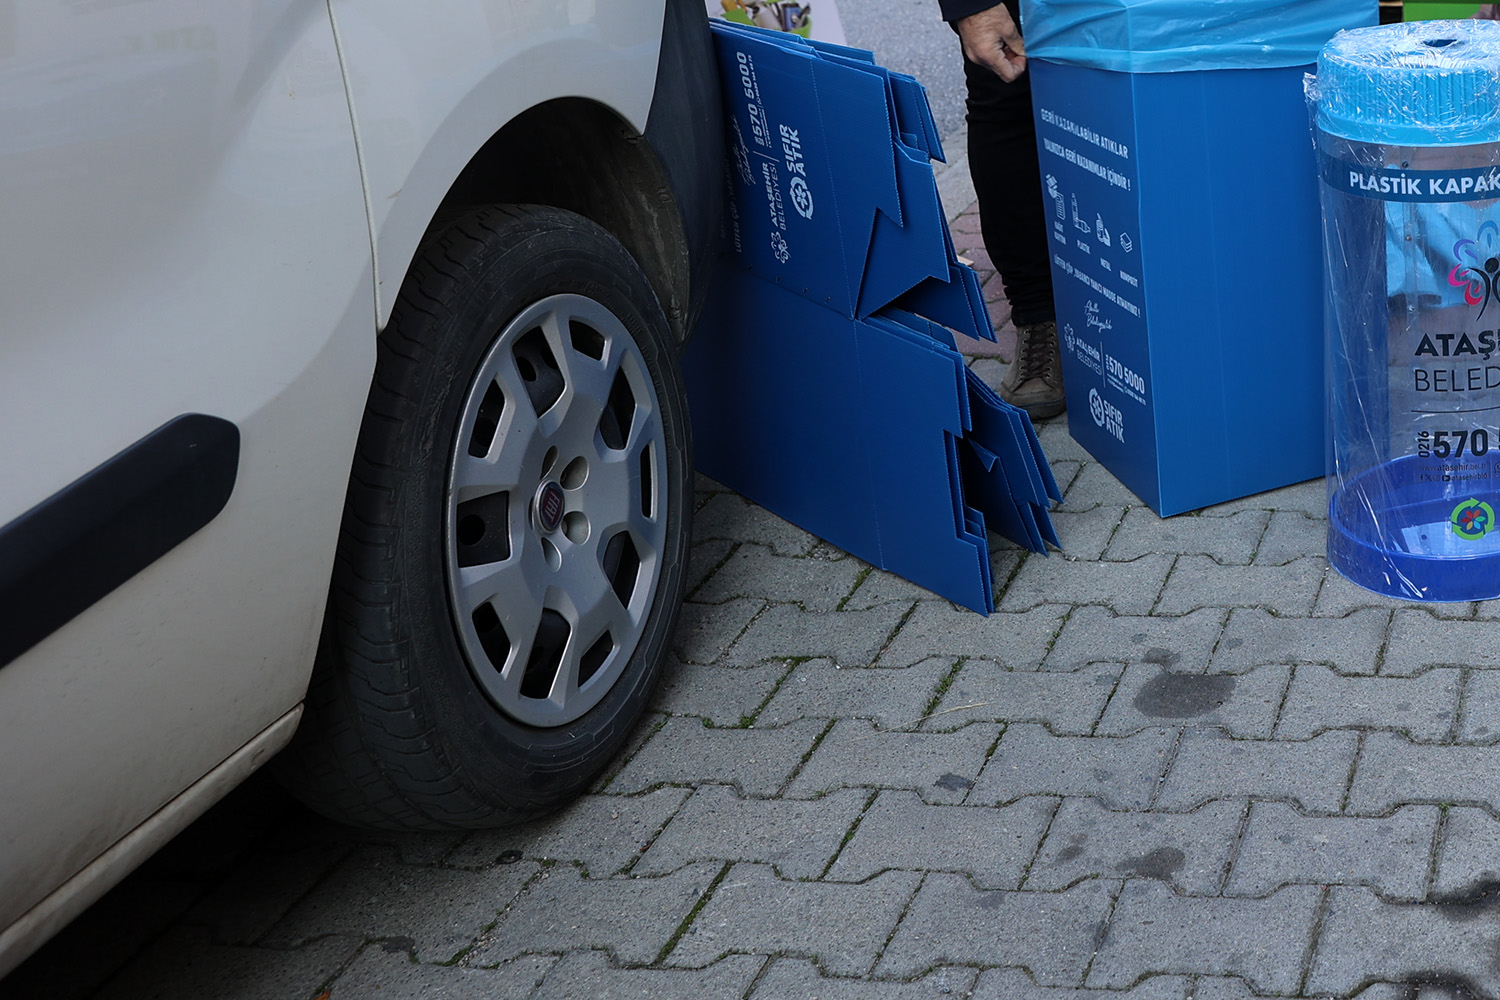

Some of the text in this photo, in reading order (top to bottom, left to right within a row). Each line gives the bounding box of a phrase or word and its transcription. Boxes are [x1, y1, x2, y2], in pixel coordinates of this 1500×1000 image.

[736, 51, 755, 100] 5000
[747, 103, 763, 137] 570
[779, 124, 797, 173] SIFIR
[788, 127, 807, 177] ATIK
[1101, 136, 1129, 159] ATIKLAR
[1350, 171, 1422, 195] PLASTİK
[1109, 356, 1123, 379] 570
[1124, 367, 1145, 394] 5000
[1104, 400, 1124, 427] SIFIR
[1106, 416, 1125, 443] ATIK
[1418, 430, 1430, 458] 0216
[1433, 429, 1489, 459] 570
[545, 491, 560, 522] FIAT
